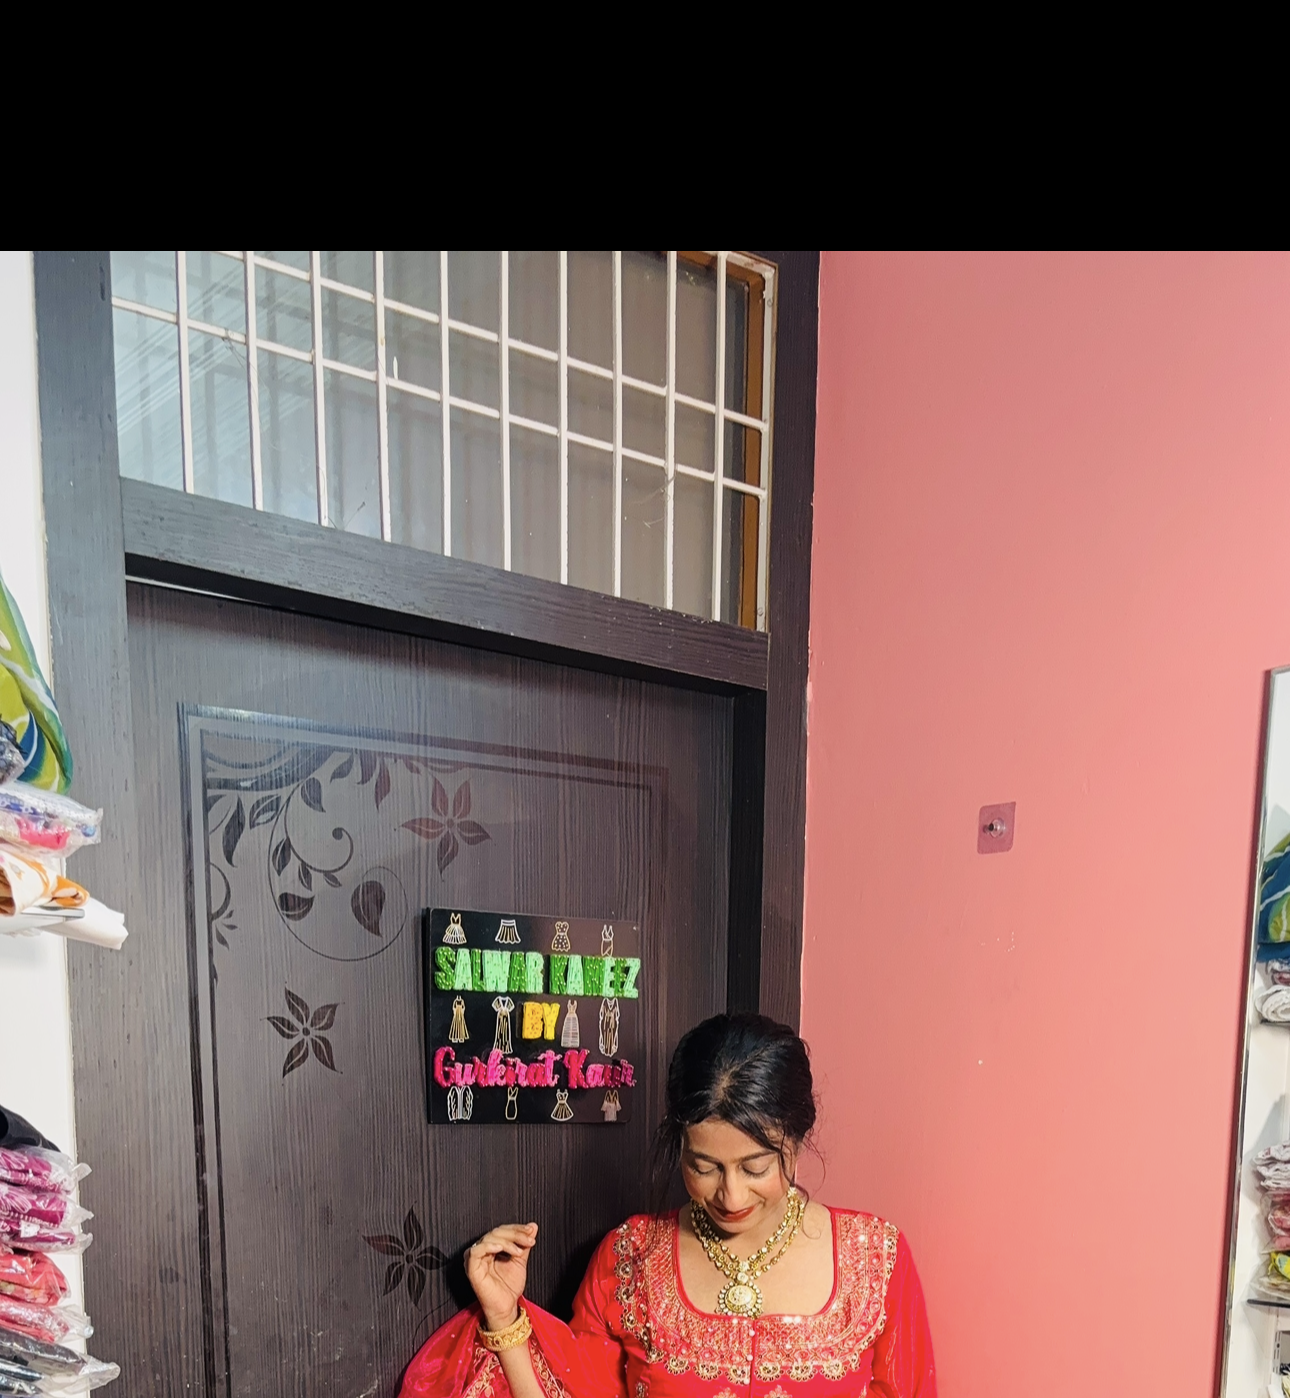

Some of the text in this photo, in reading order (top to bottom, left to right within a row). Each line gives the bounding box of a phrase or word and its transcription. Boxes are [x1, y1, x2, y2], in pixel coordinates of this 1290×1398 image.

[434, 946, 641, 998] SALWAR KAMEEZ
[521, 1001, 561, 1040] BY
[434, 1046, 637, 1089] Gurkirat Kaur
